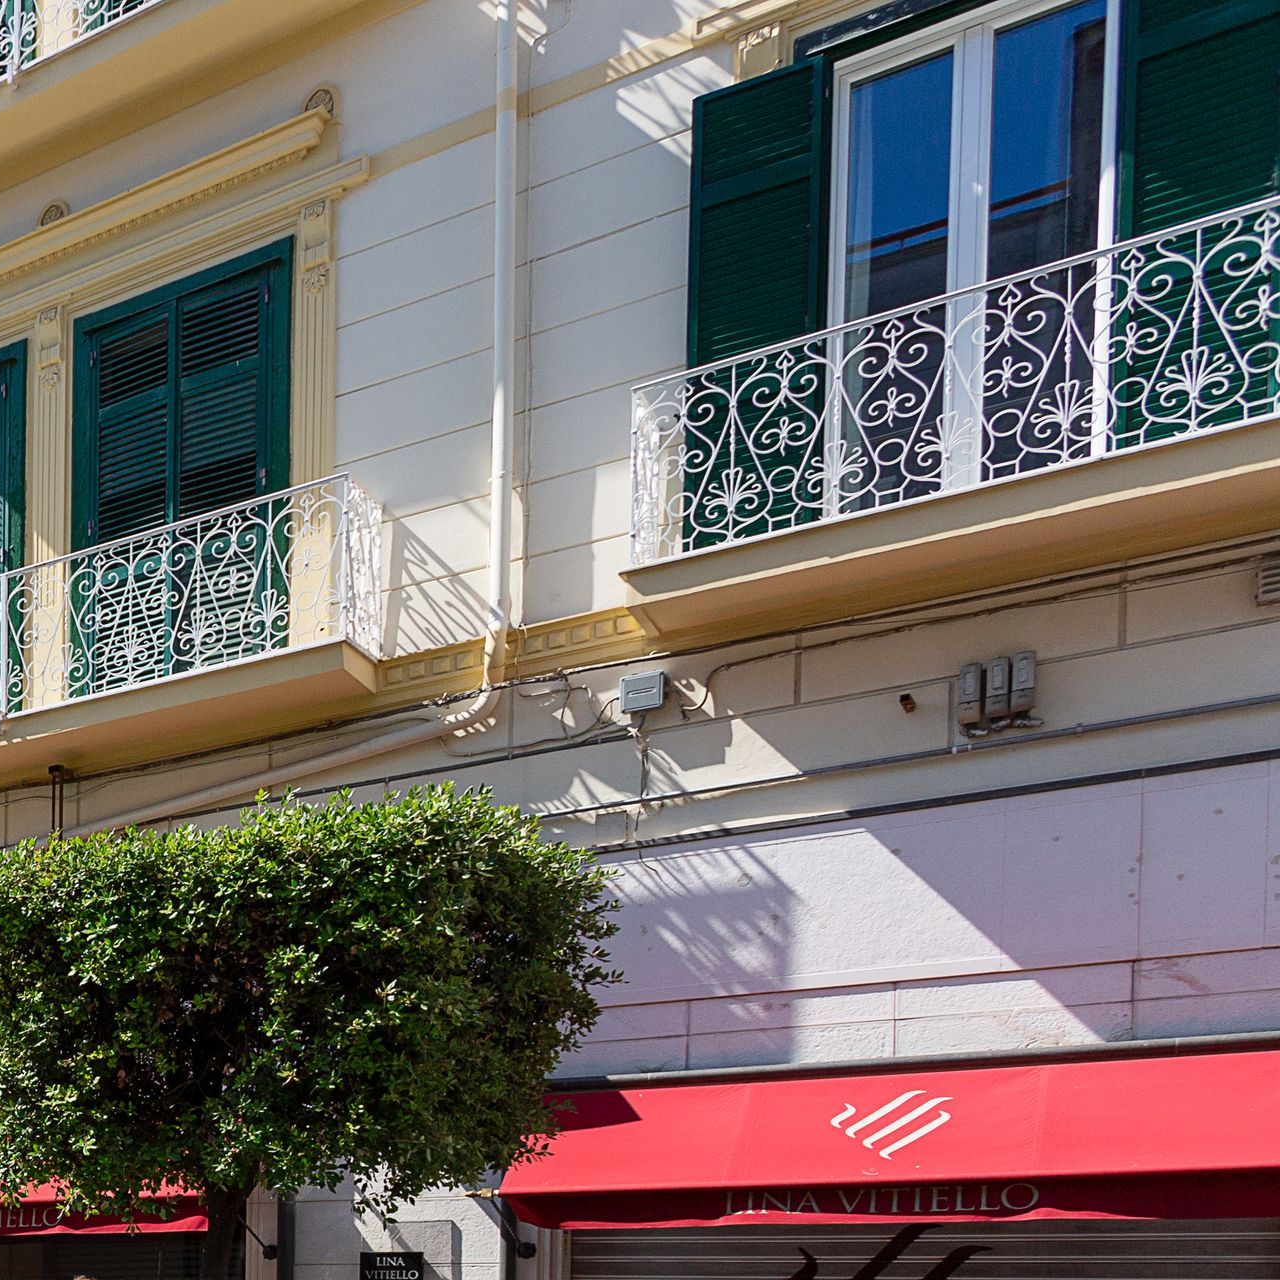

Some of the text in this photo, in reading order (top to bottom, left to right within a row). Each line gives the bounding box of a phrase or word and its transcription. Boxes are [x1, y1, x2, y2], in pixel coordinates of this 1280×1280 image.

[725, 1183, 1040, 1214] LINA VITIELLO
[376, 1256, 406, 1267] LINA
[365, 1269, 419, 1280] VITIELLO
